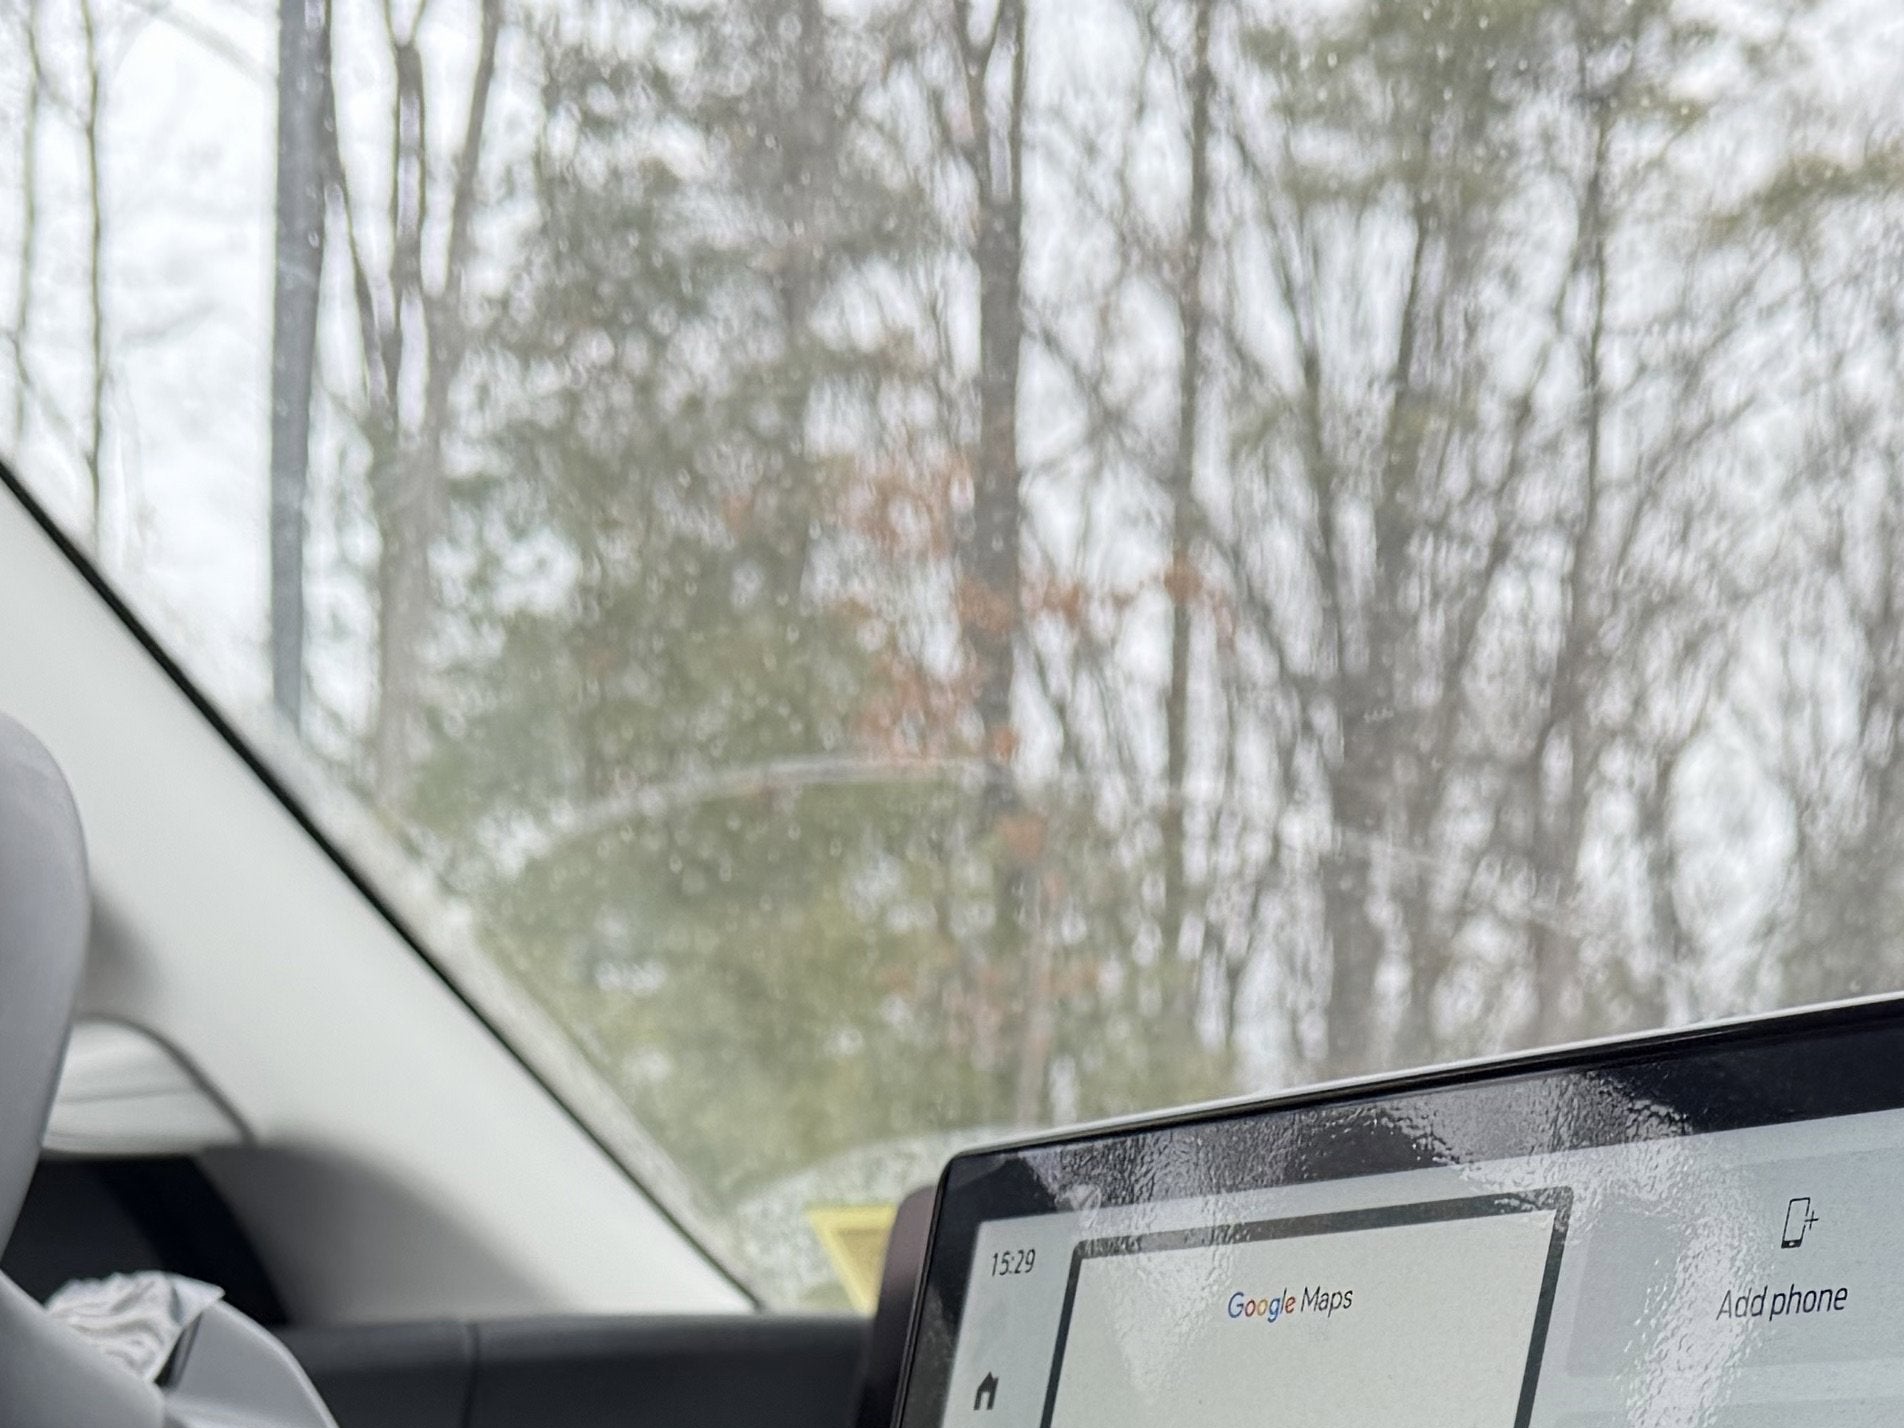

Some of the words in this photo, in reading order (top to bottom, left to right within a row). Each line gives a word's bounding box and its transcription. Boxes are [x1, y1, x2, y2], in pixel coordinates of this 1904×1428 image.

[992, 1249, 1036, 1276] 15:29
[1228, 1288, 1296, 1323] Google
[1299, 1286, 1353, 1318] Maps
[1716, 1285, 1768, 1321] Add
[1769, 1283, 1848, 1321] phone
